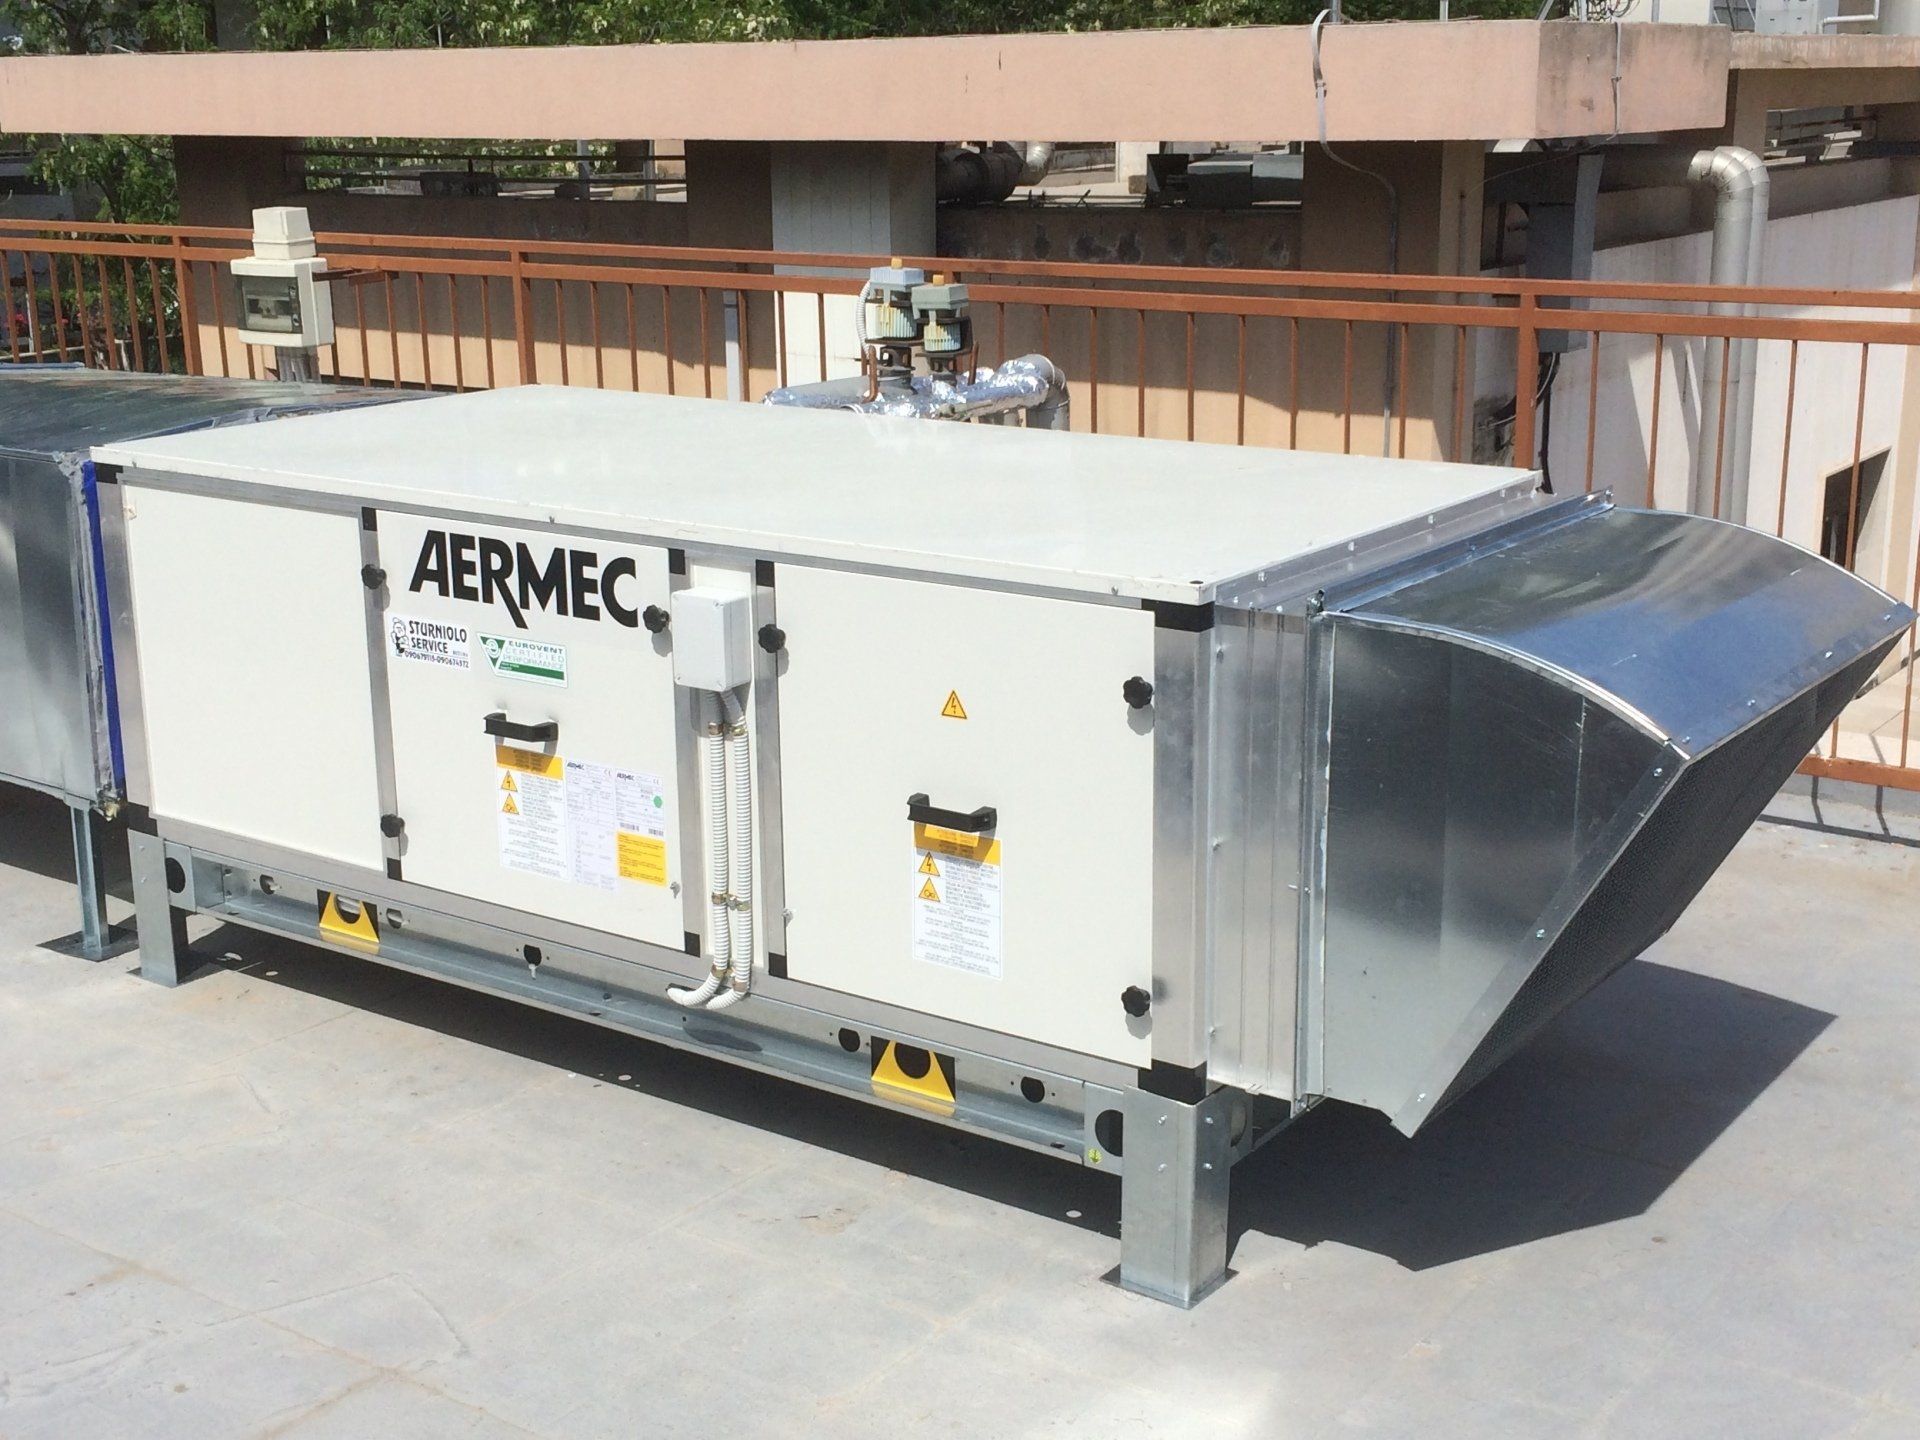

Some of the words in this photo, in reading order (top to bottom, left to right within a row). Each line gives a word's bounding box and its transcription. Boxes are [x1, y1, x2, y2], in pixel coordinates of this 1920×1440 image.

[409, 529, 639, 630] AERMEC
[409, 620, 467, 643] STURNIOLO
[411, 637, 448, 654] SERVICE
[508, 640, 563, 654] EUROVENT
[502, 654, 565, 670] PERFORMANCE
[505, 647, 565, 663] CERTIFIED
